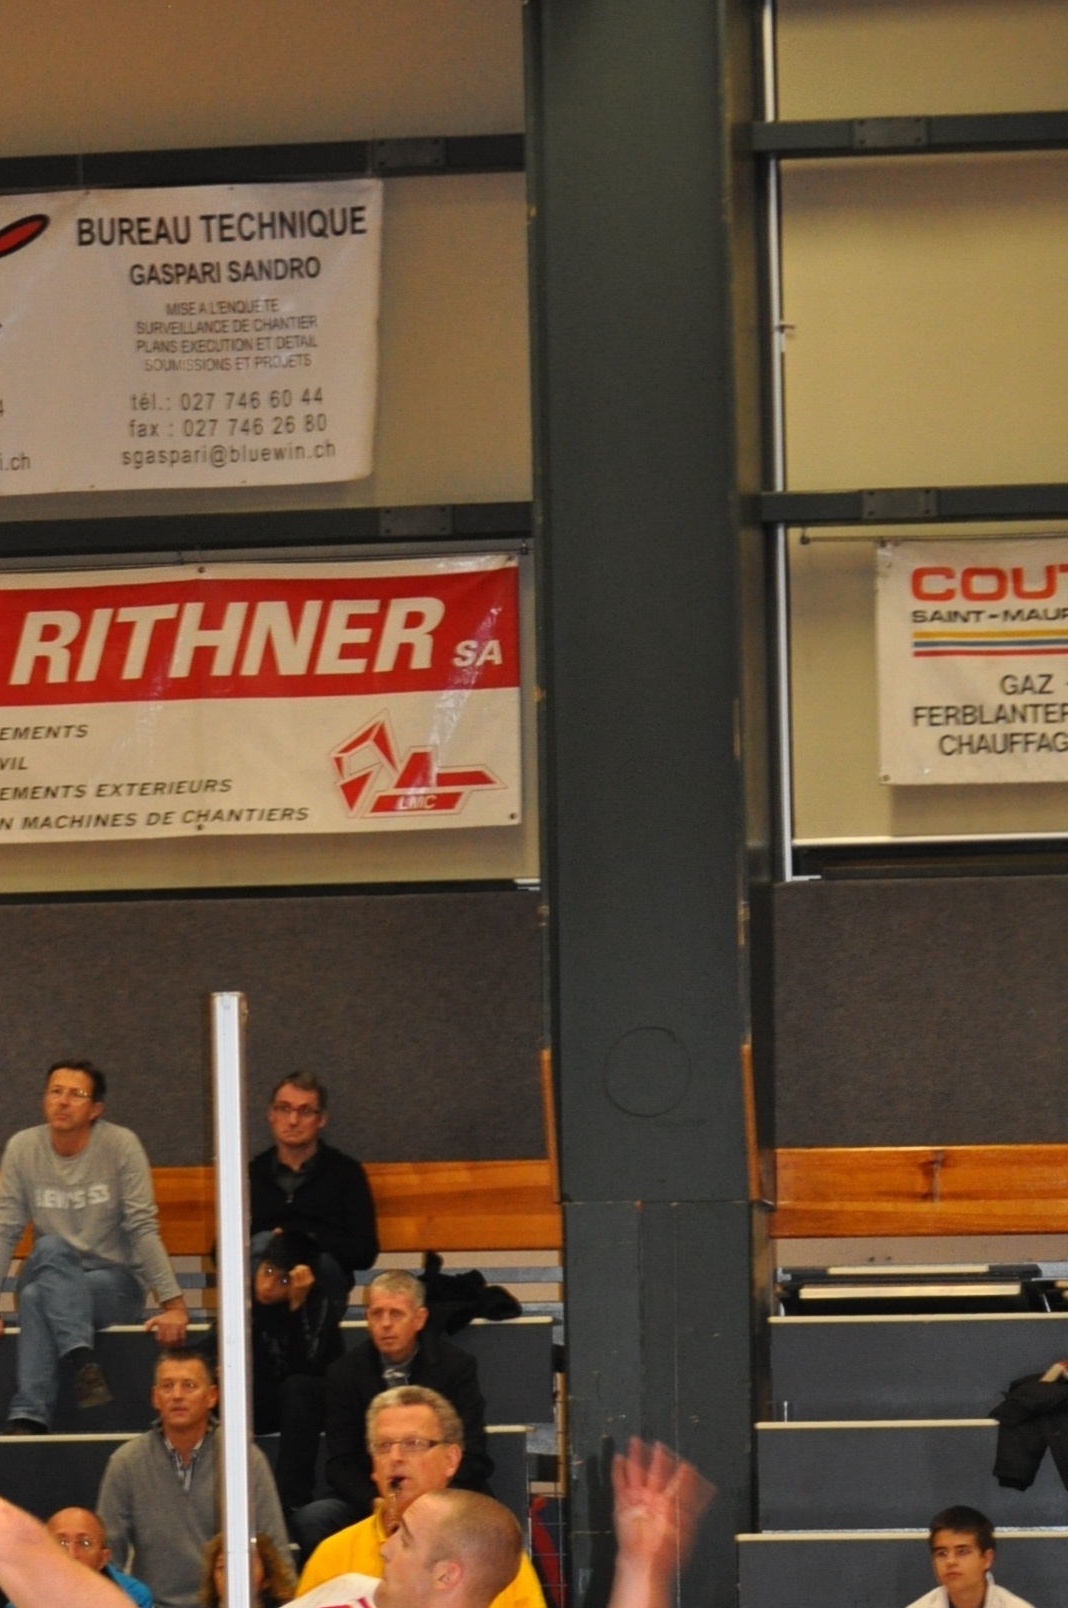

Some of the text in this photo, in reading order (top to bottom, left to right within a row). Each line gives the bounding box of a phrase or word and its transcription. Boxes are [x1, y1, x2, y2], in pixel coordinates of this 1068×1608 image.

[76, 206, 367, 246] BUREAU TECHNIQUE
[130, 256, 321, 286] GASPARI SANDRO
[166, 302, 196, 315] MISE
[136, 315, 318, 335] SURVEILLANCE DE CHANTIER
[136, 335, 318, 353] PLANS EXECUTION ET DETAIL
[145, 354, 312, 372] SOUMISSIONS ET PROJETS
[180, 392, 216, 412] 027
[225, 390, 262, 410] 746
[270, 390, 294, 408] 60
[300, 388, 324, 407] 44
[128, 418, 161, 439] fax
[182, 418, 219, 438] 027
[228, 416, 264, 436] 746
[272, 415, 296, 434] 26
[304, 414, 328, 432] 80
[121, 440, 336, 469] sgaspari@bluewin.ch
[9, 597, 445, 686] RITHNER
[452, 639, 504, 668] SA
[1000, 674, 1054, 696] GAZ
[94, 778, 233, 797] EXTERIEURS
[394, 794, 438, 810] LMC
[20, 812, 139, 831] MACHINES
[144, 811, 175, 826] DE
[181, 807, 310, 825] CHANTIERS
